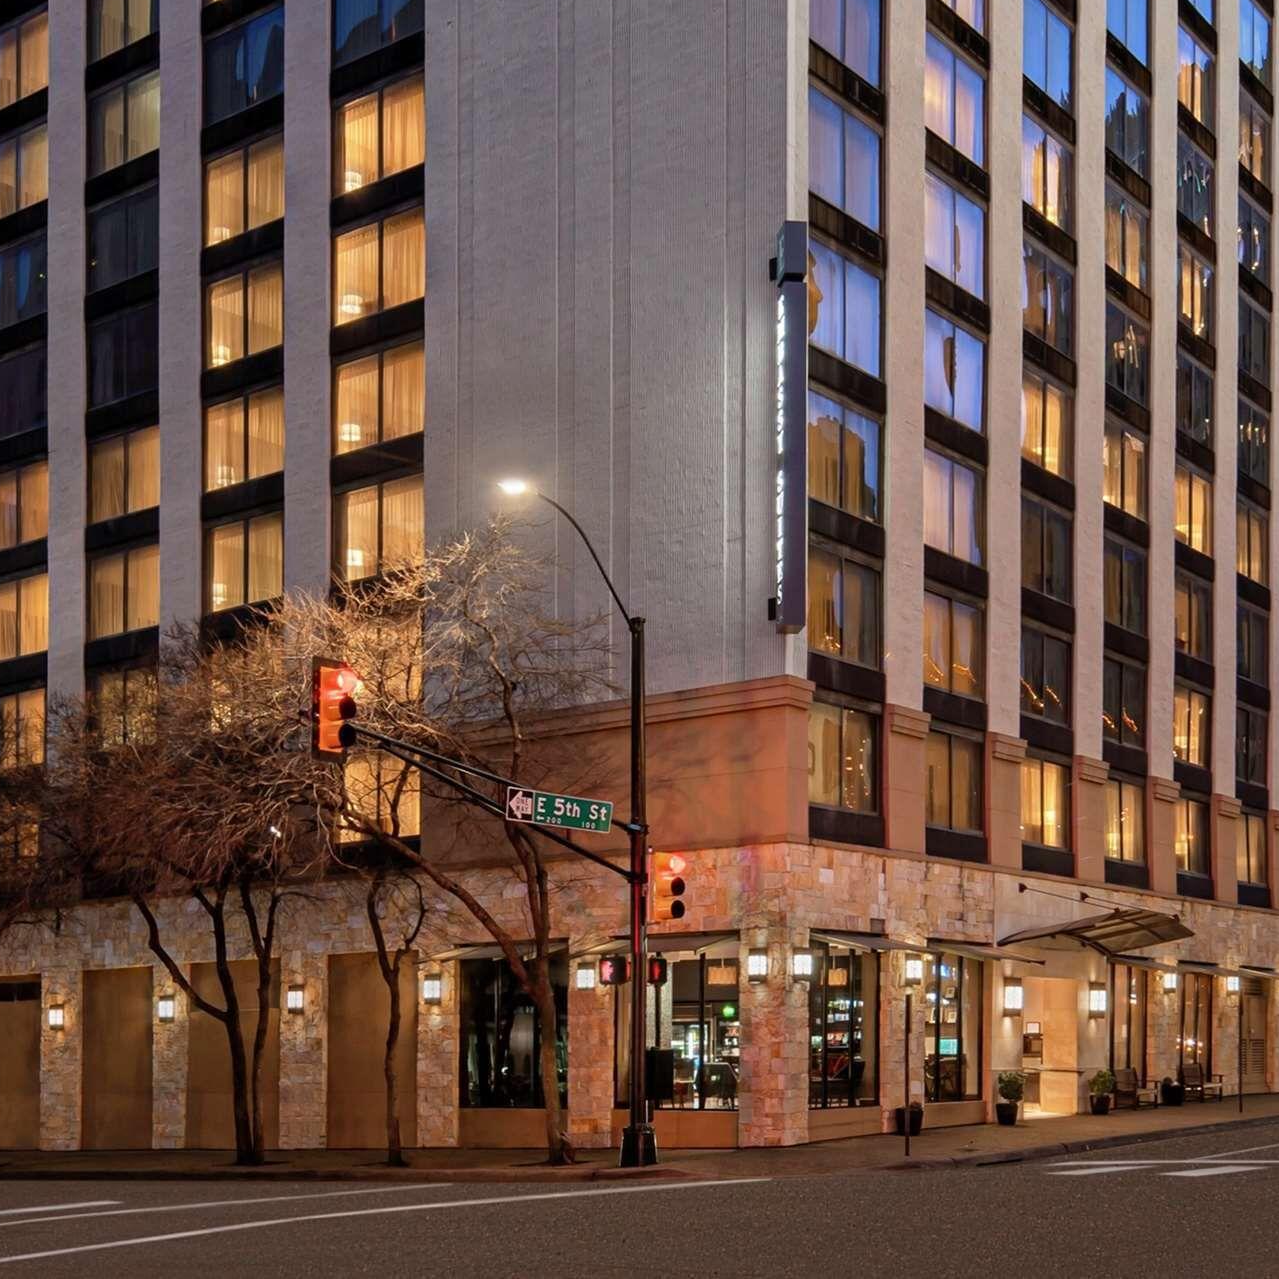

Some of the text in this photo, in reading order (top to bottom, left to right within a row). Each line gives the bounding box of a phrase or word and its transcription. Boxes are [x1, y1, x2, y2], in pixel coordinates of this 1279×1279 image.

[776, 469, 785, 605] SUITES
[537, 797, 607, 821] E 5th St
